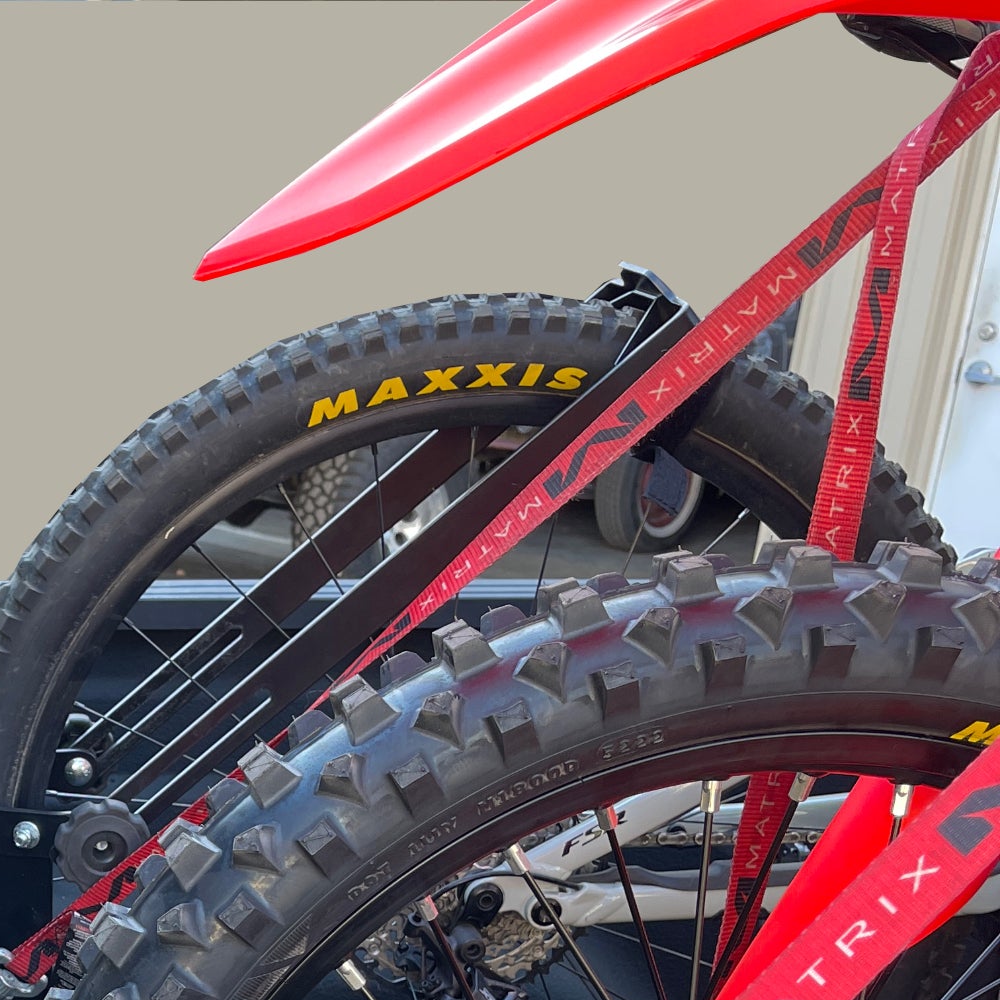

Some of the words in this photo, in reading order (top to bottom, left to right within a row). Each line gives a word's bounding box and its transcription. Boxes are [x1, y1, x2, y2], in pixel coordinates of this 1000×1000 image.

[929, 88, 996, 154] RIX
[649, 266, 797, 401] MATRIX
[308, 363, 588, 427] MAXXIS
[825, 413, 863, 548] ATRIX
[420, 496, 542, 610] MATRIX
[745, 772, 781, 869] MATR
